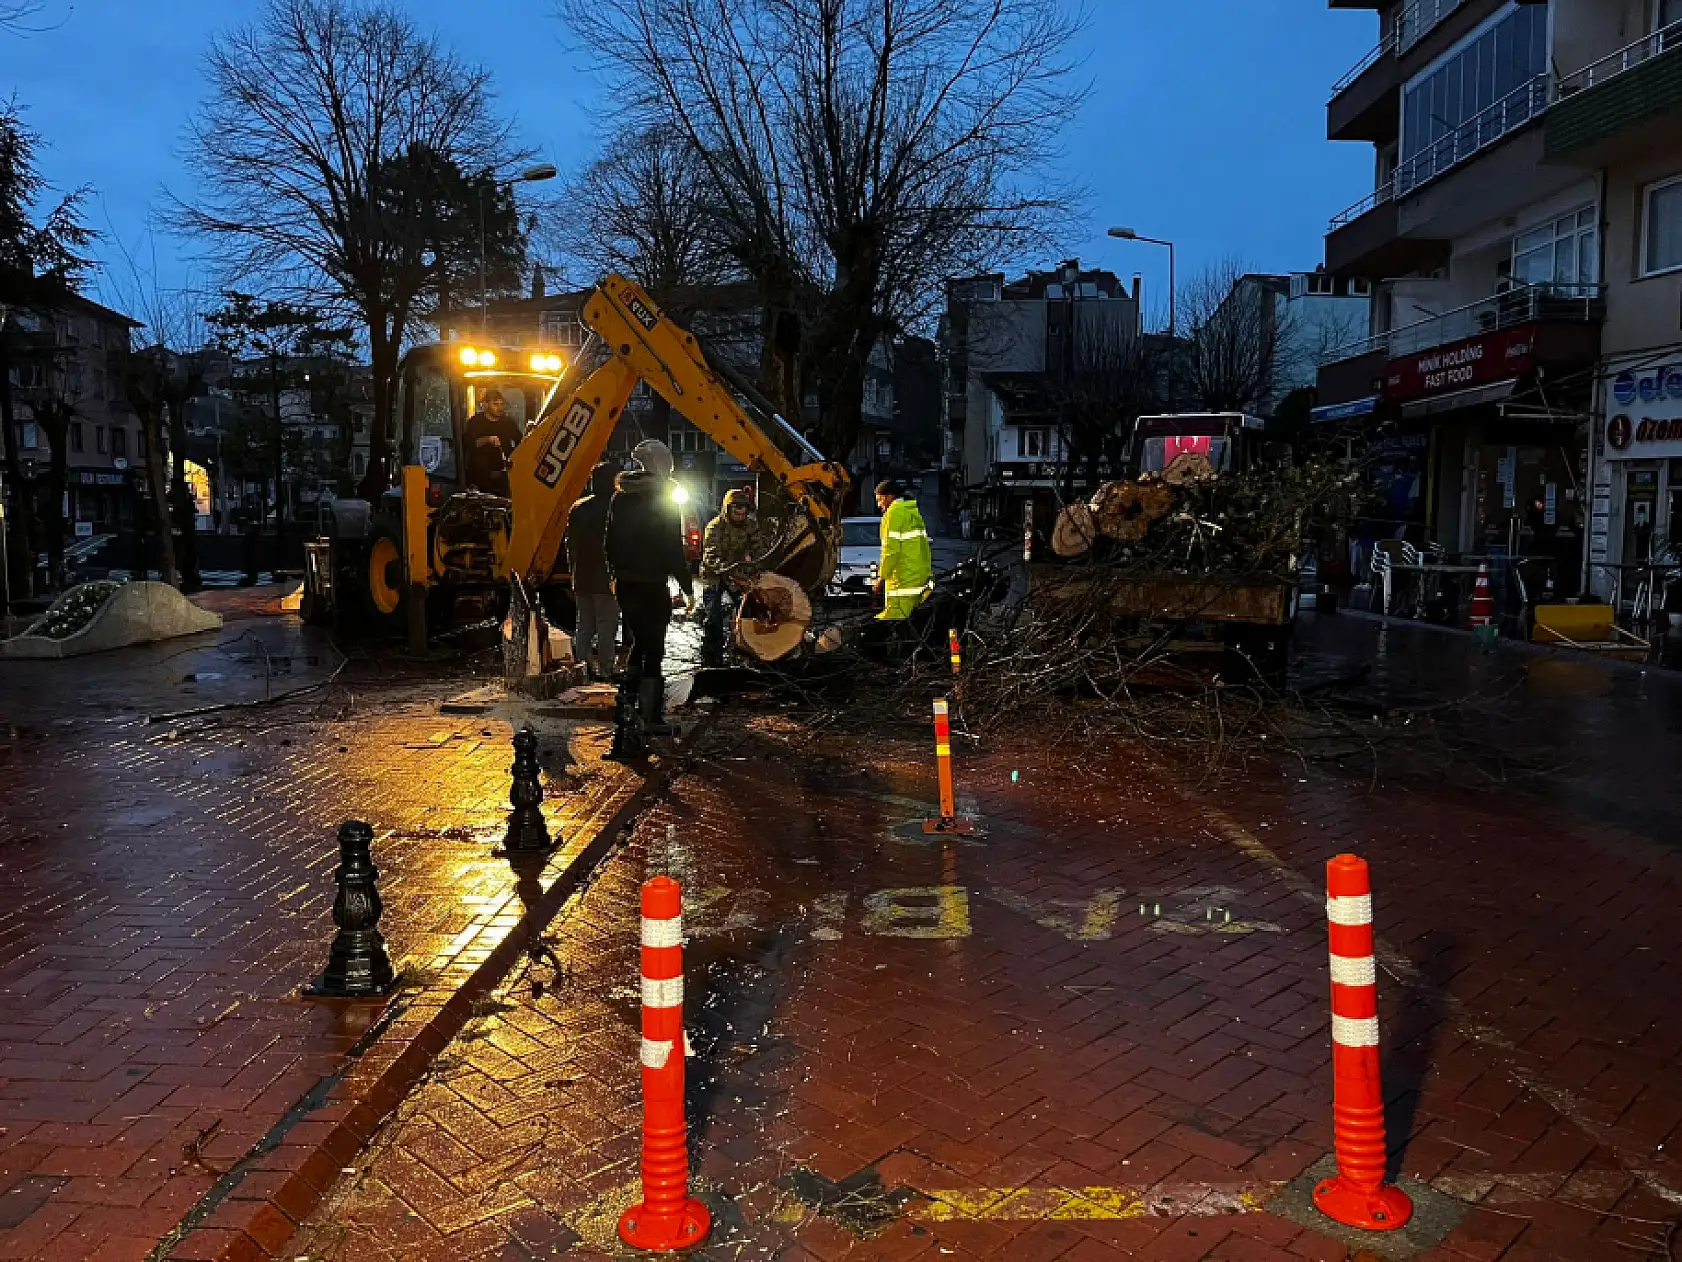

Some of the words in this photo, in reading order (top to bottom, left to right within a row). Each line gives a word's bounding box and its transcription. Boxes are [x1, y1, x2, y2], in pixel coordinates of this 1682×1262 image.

[1424, 371, 1446, 388] FAST
[1448, 365, 1473, 383] FOOD
[540, 403, 592, 483] JCB
